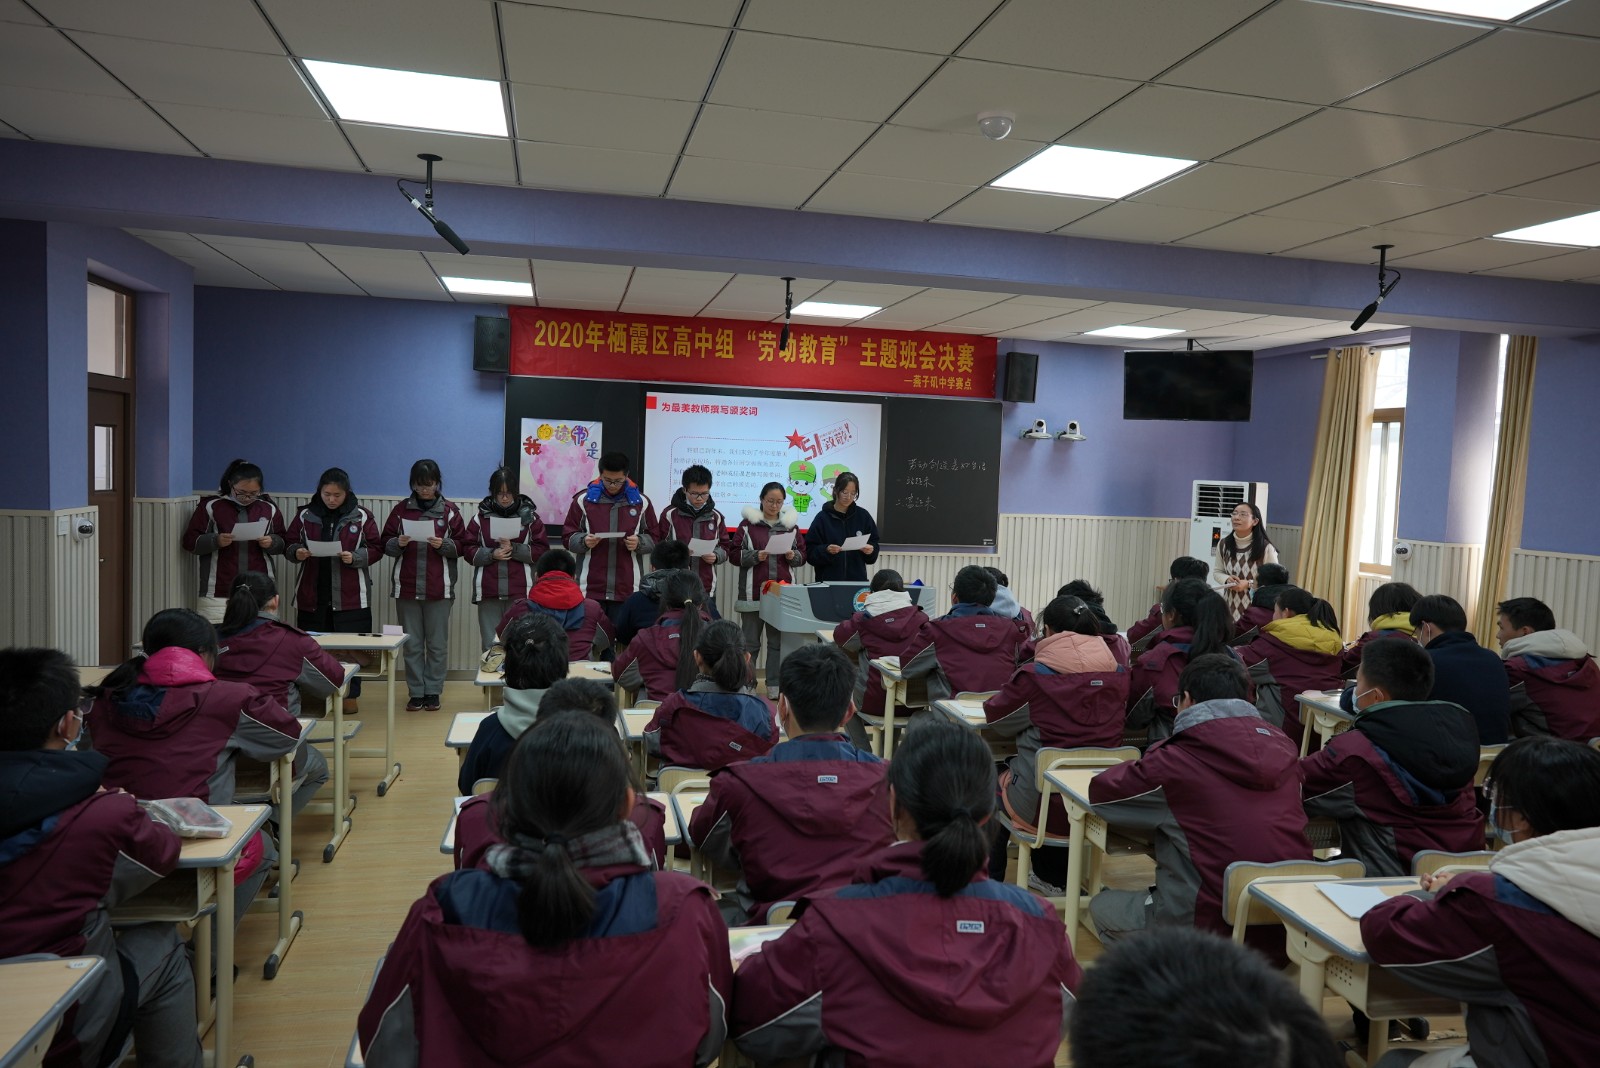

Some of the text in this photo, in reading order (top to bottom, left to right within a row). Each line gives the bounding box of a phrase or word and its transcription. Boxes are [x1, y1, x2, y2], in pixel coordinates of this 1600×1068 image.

[534, 320, 734, 359] 2020年栖霞区高中组
[860, 338, 975, 373] 主题班会决赛
[662, 402, 758, 416] 为最美教师撰写颁奖词
